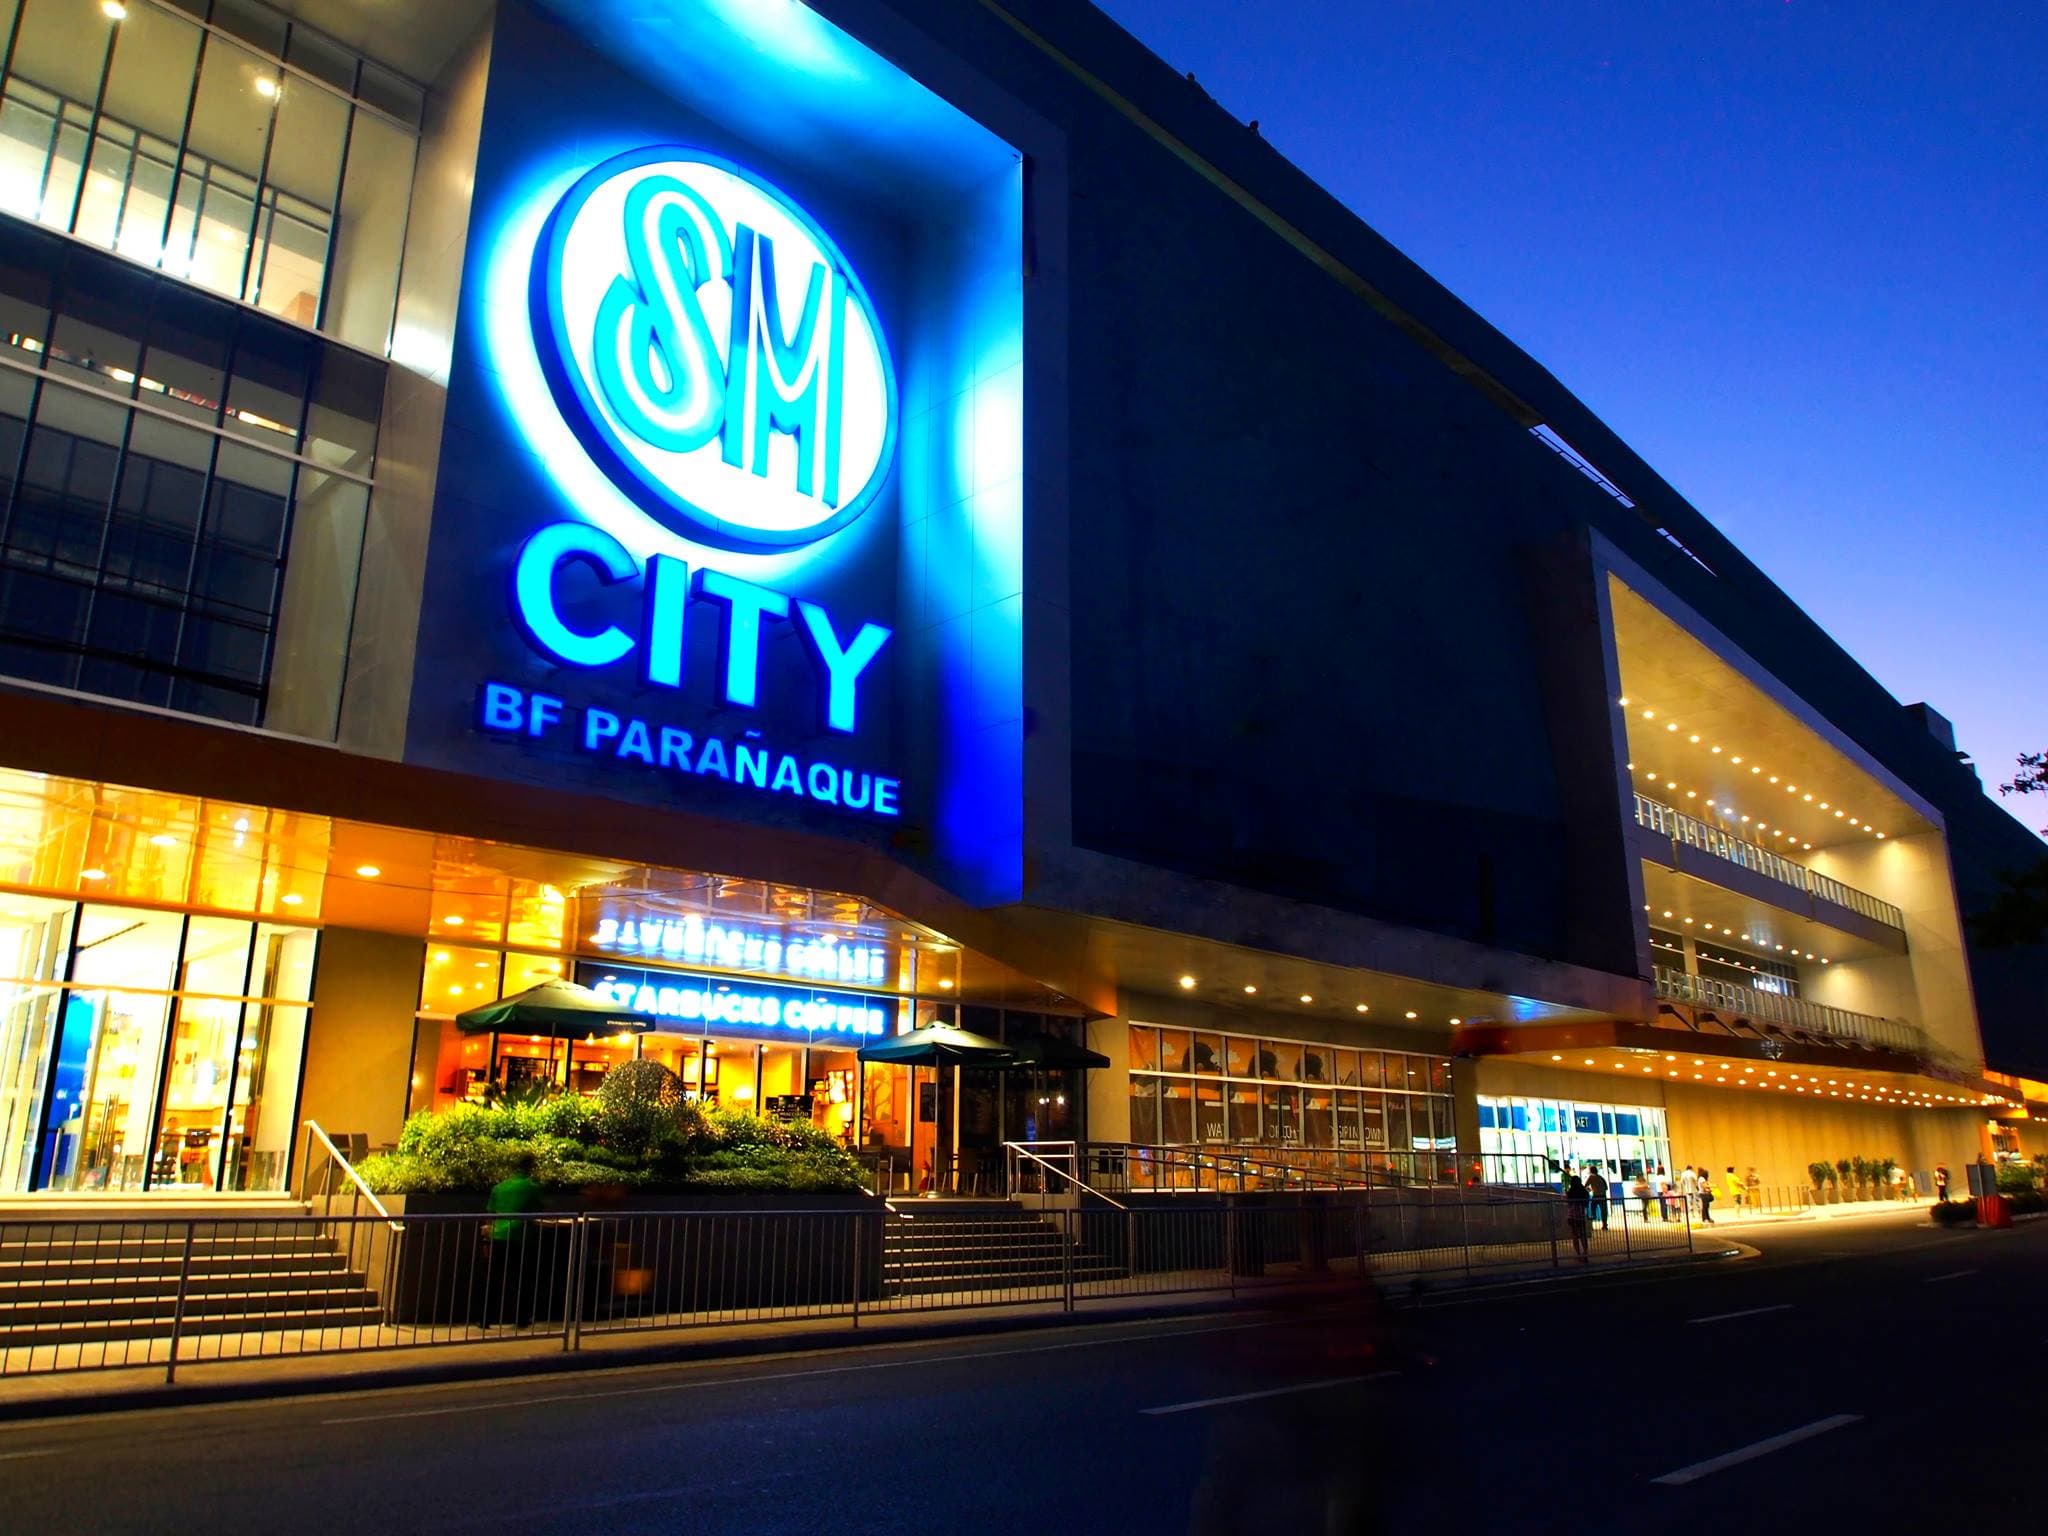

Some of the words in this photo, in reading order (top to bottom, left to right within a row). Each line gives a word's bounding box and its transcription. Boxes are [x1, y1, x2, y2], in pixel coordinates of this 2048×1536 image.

[593, 174, 849, 511] SM
[514, 520, 893, 734] CITY
[484, 682, 563, 737] BF
[584, 706, 899, 816] PARAÑAQUE
[783, 1001, 884, 1035] COFFEE
